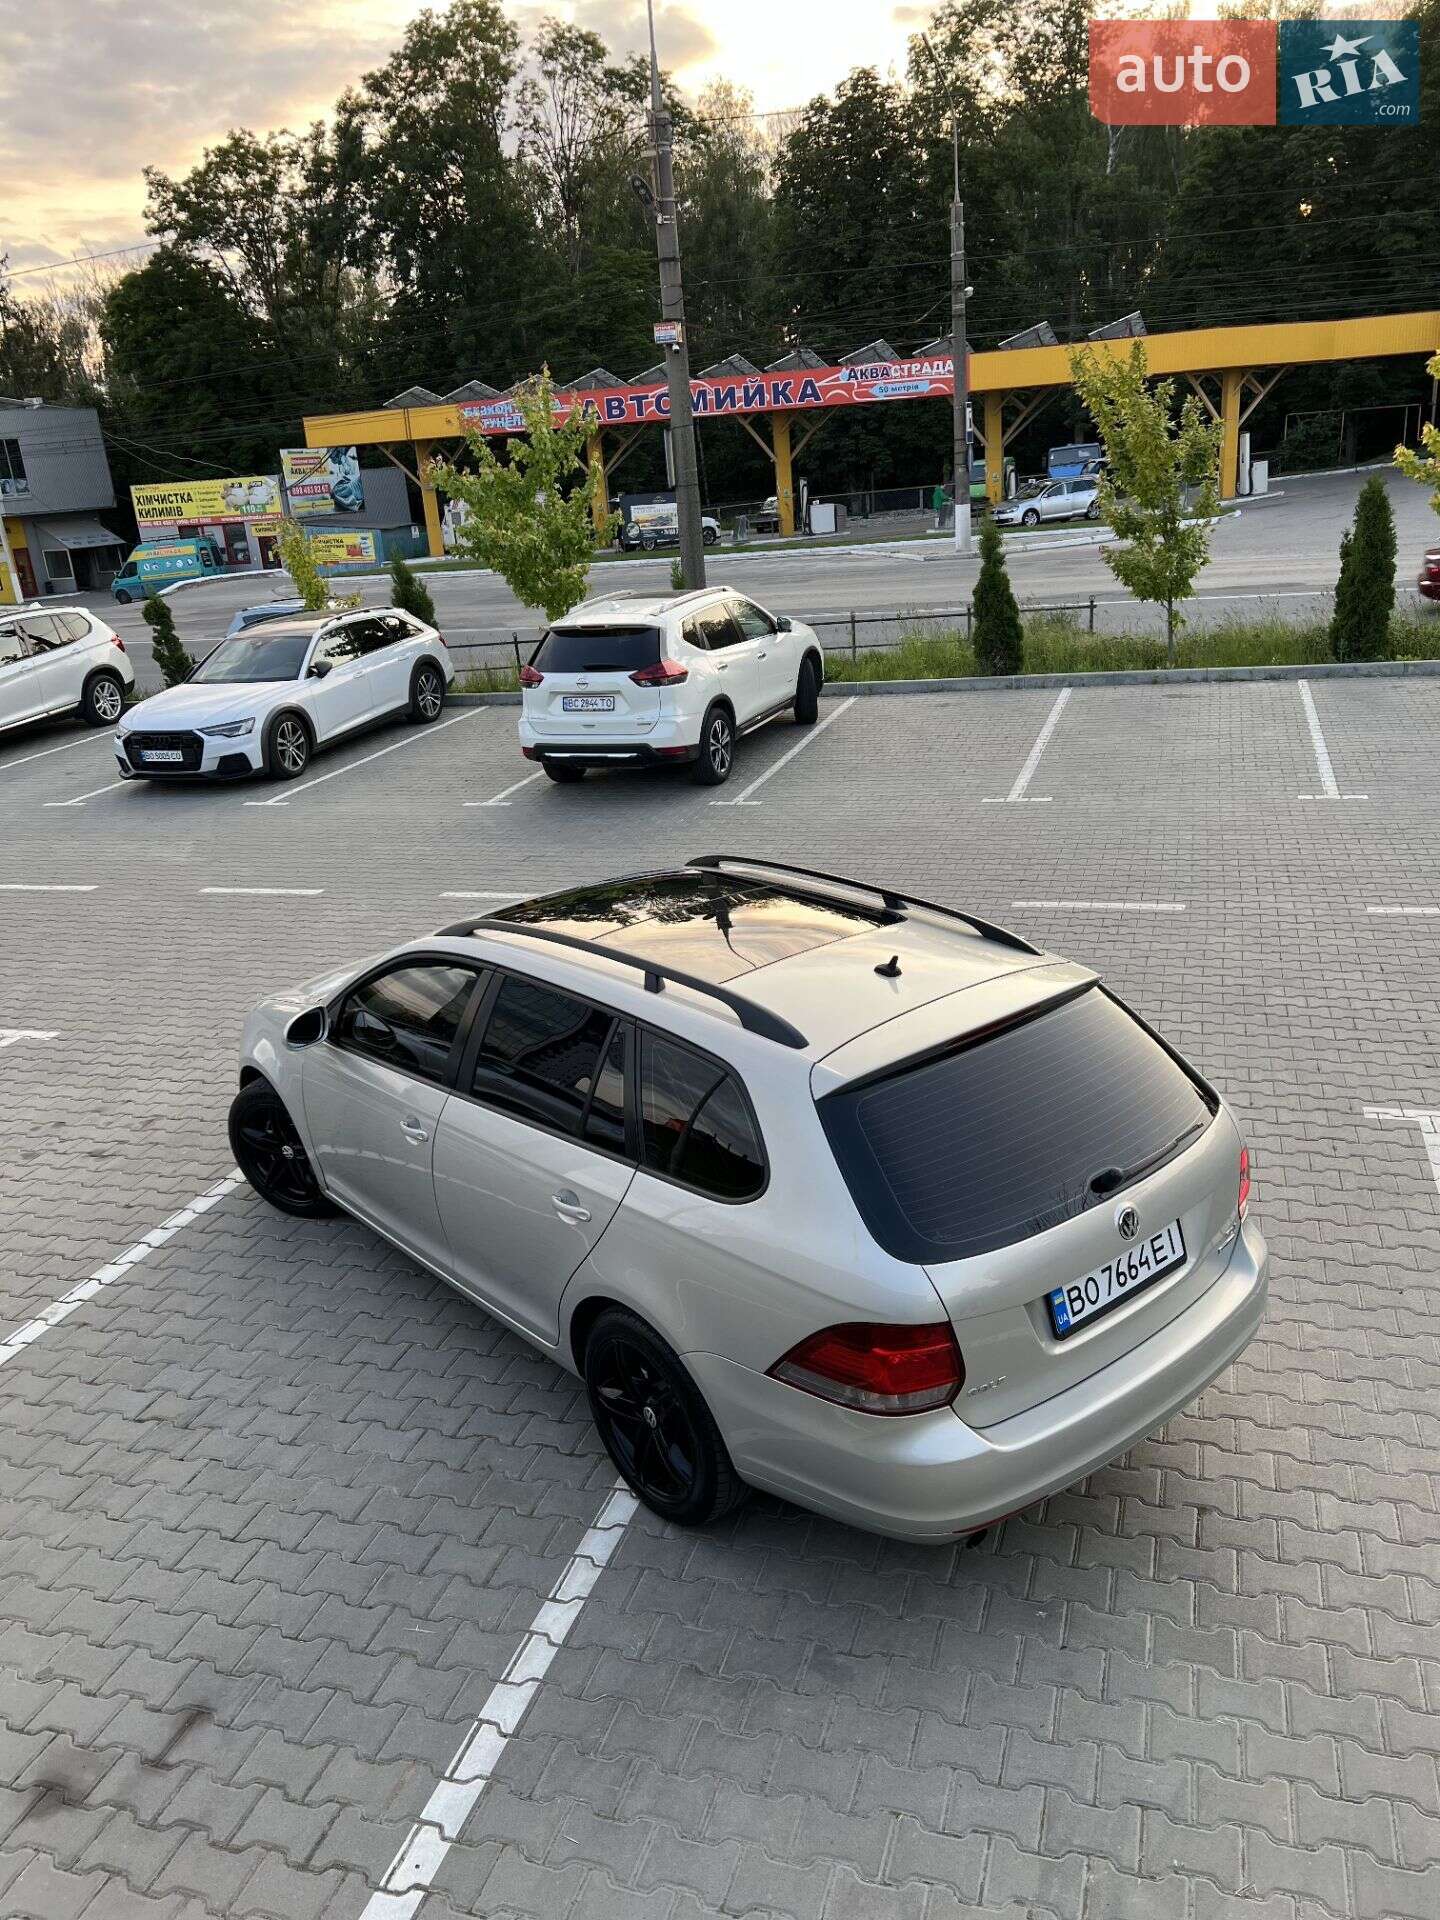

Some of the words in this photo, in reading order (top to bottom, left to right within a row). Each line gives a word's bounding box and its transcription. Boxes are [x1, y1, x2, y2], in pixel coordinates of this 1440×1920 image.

[848, 359, 955, 382] АКВАСТРАДА
[878, 385, 889, 394] 50
[891, 383, 919, 393] метрів
[580, 377, 824, 422] АВТОМИЙКА
[134, 492, 194, 507] ХІМЧИСТКА
[138, 506, 184, 519] КИЛИМІВ
[1101, 1244, 1151, 1297] 7664
[1058, 1314, 1070, 1326] UA
